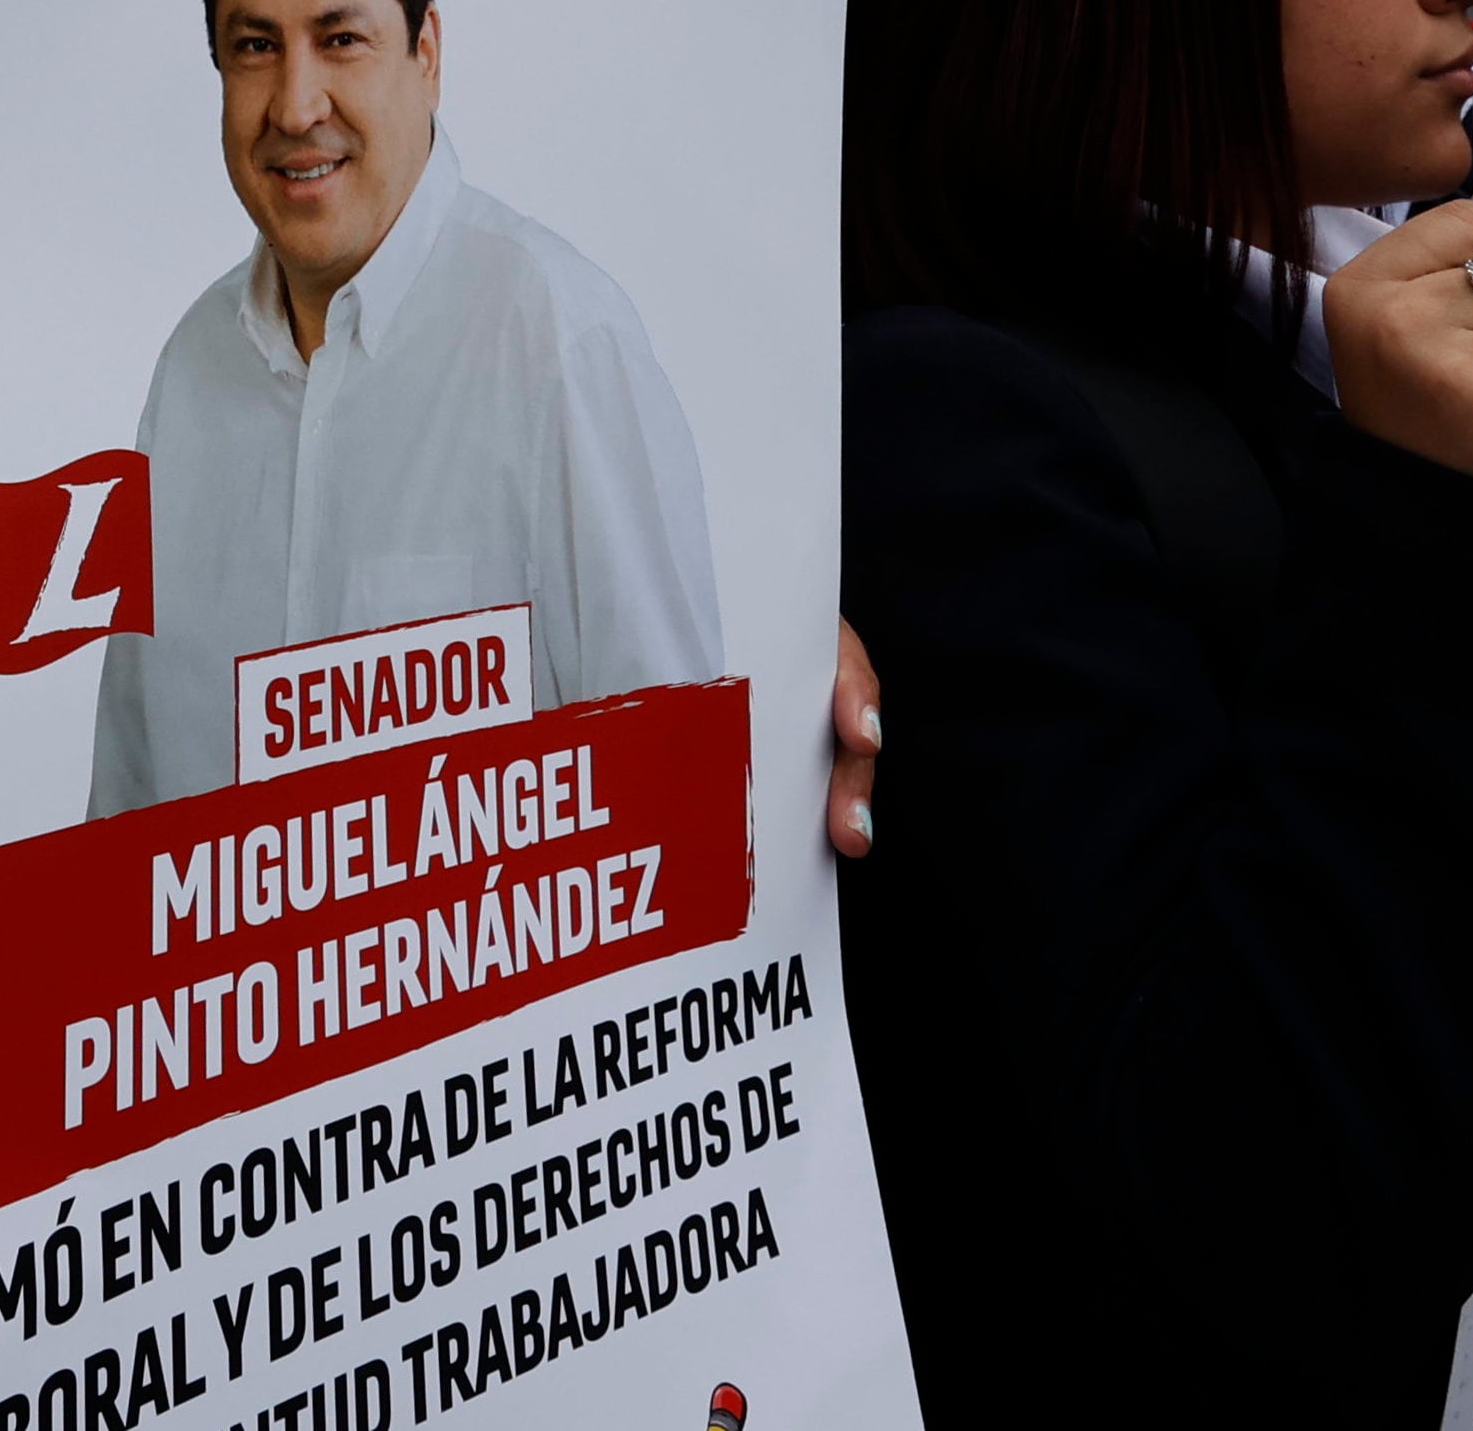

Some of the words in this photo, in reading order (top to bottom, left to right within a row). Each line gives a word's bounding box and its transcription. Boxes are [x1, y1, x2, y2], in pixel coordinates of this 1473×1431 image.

[9, 476, 124, 646] L
[263, 634, 511, 760] SENADOR
[150, 795, 409, 957] MIGUEL
[412, 743, 611, 879] ÁNGEL
[64, 960, 280, 1132] PINTO
[296, 844, 665, 1048] HERNÁNDEZ
[99, 1180, 183, 1304] EN
[198, 1087, 436, 1256] CONTRA
[443, 1059, 515, 1151] DE
[523, 1031, 586, 1124] LA
[593, 952, 813, 1104] REFORMA
[212, 1282, 255, 1382] Y
[267, 1245, 345, 1364] DE
[356, 1197, 462, 1323] LOS
[473, 1090, 732, 1273] DERECHOS
[737, 1062, 801, 1157] DE
[400, 1185, 780, 1428] TRABAJADORA
